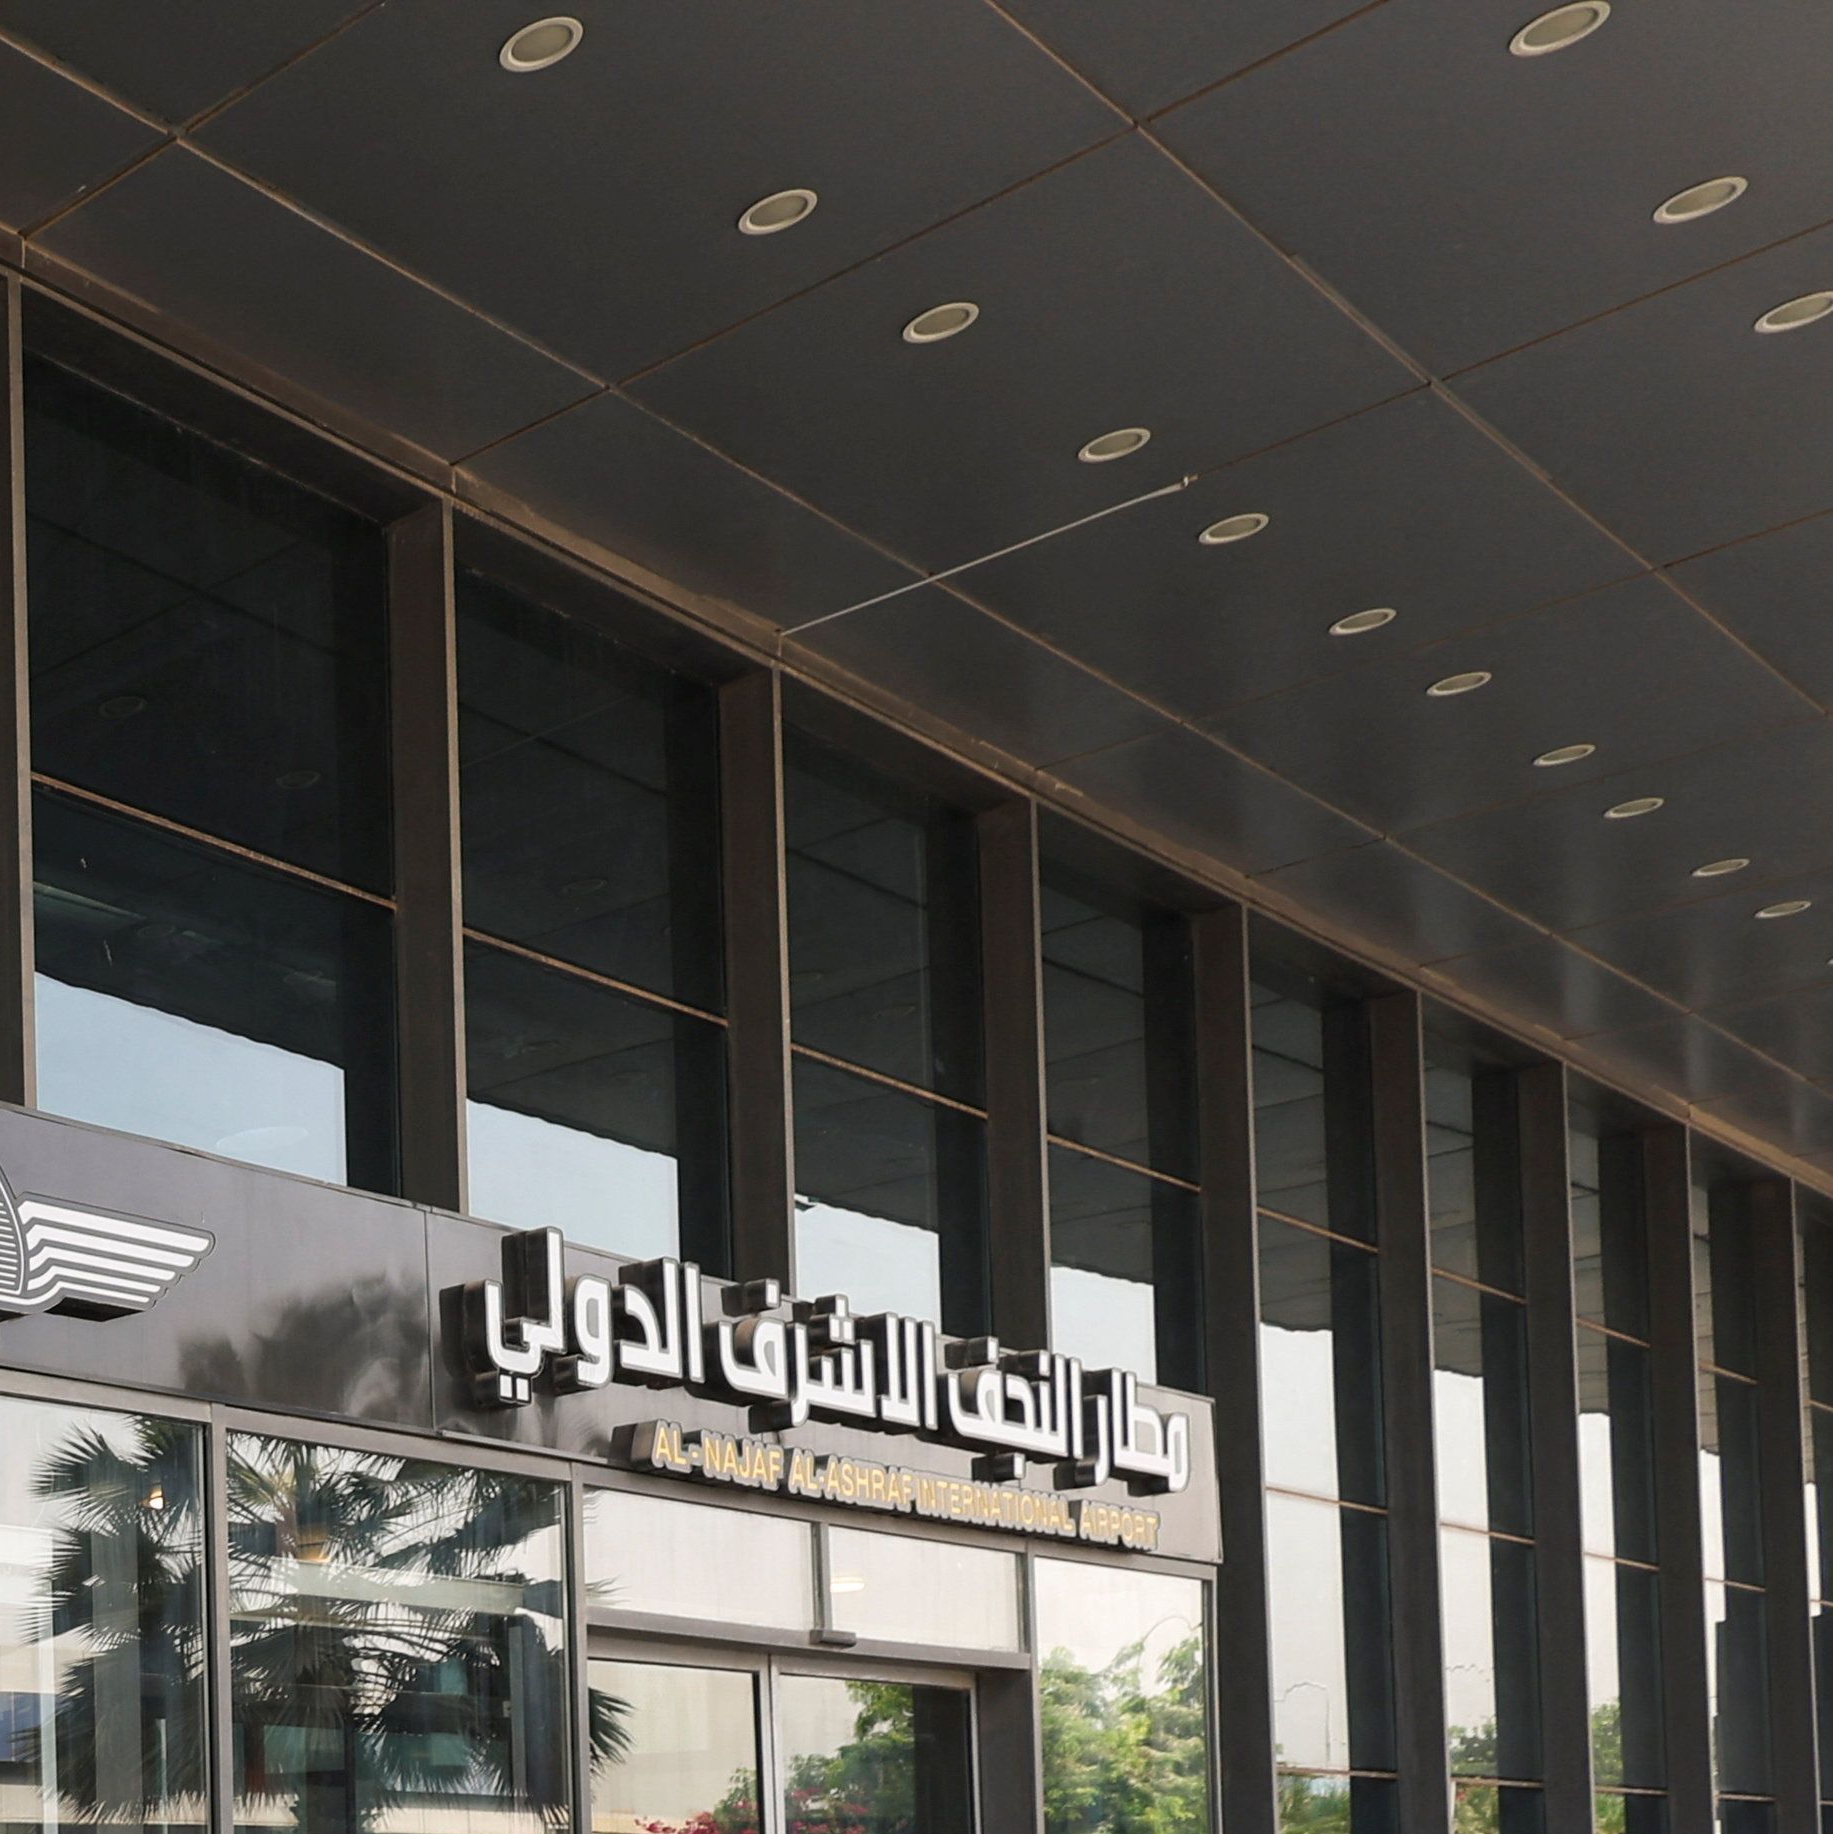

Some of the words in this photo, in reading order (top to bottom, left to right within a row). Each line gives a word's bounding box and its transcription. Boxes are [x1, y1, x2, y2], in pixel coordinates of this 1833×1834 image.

[484, 1226, 704, 1400] الدولي
[719, 1279, 938, 1430] الاشرف
[947, 1336, 1083, 1479] النجف
[1094, 1368, 1188, 1491] مطار
[791, 1450, 913, 1505] AL-ASHRAF
[917, 1478, 1074, 1531] INTERNATIONAL
[1080, 1502, 1158, 1547] AIRPORT
